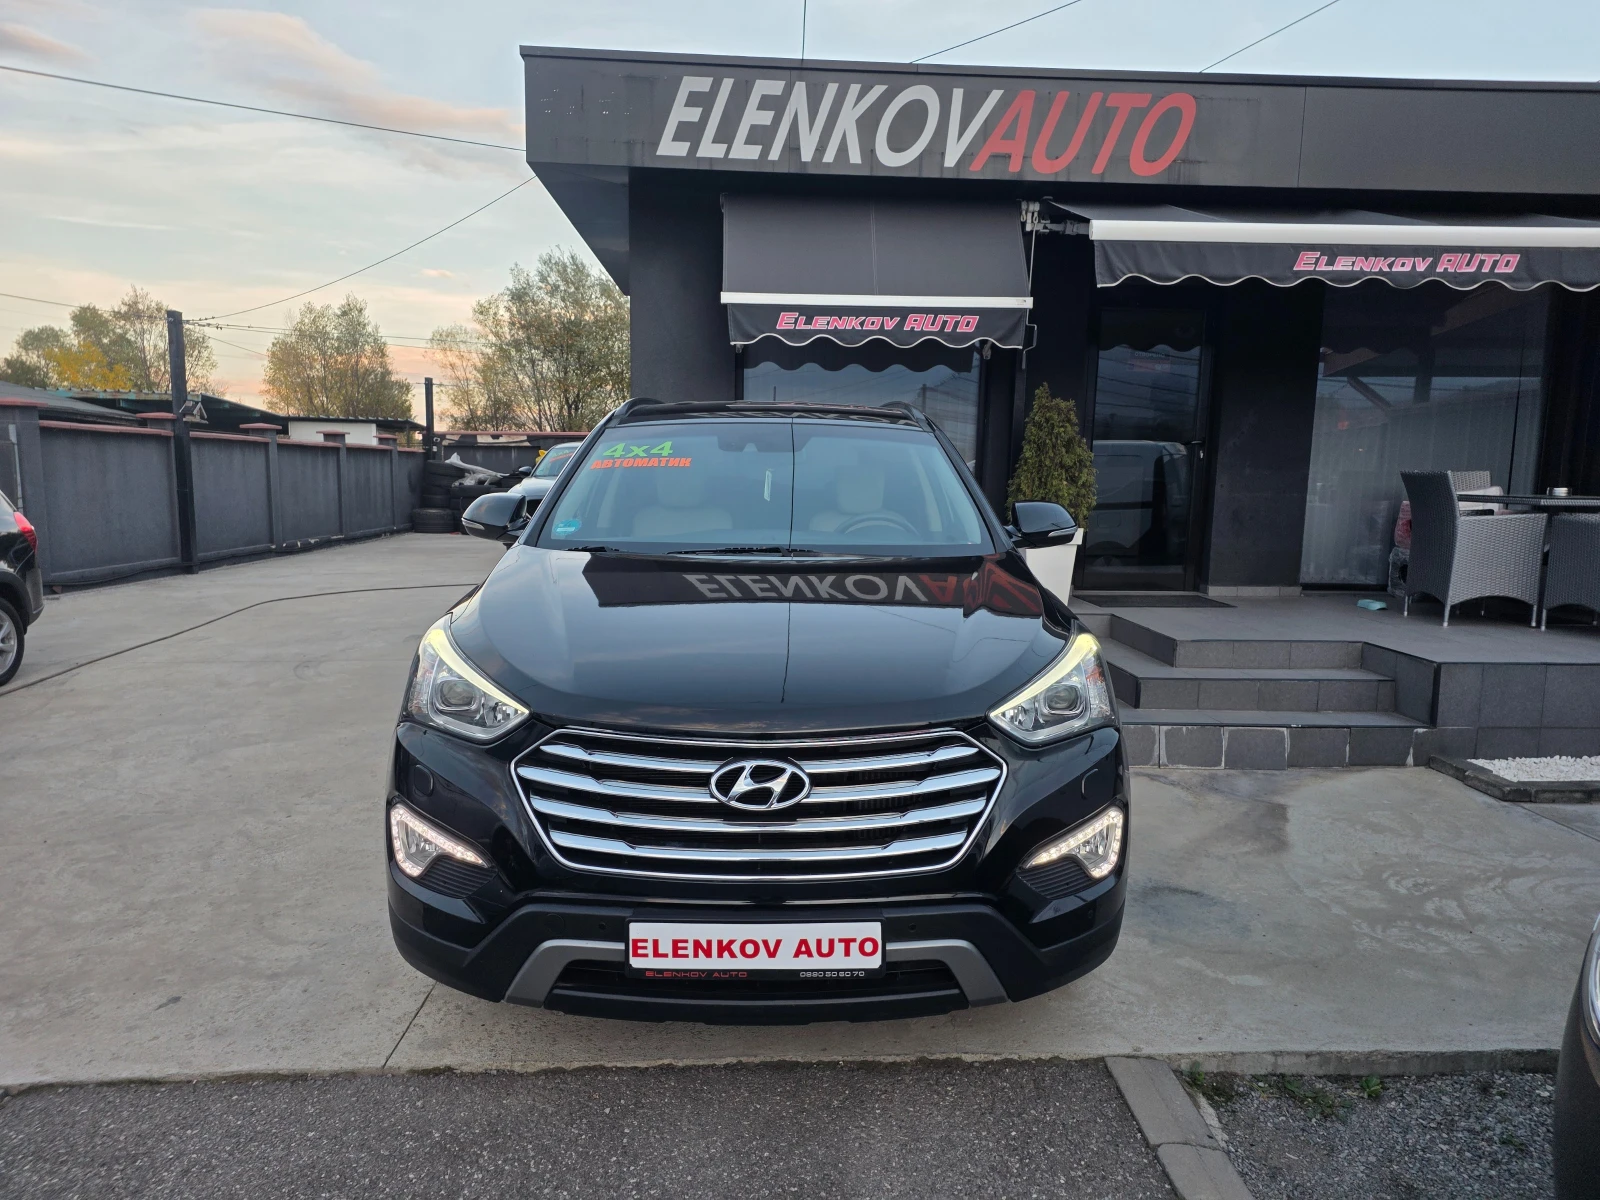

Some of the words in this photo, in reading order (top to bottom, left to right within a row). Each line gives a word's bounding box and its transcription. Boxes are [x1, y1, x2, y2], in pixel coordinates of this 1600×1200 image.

[1436, 253, 1521, 273] AUTO
[904, 313, 980, 332] AUTO
[589, 457, 693, 470] АВТОМАТИК
[631, 938, 783, 959] ELENKOV
[792, 936, 880, 959] AUTO
